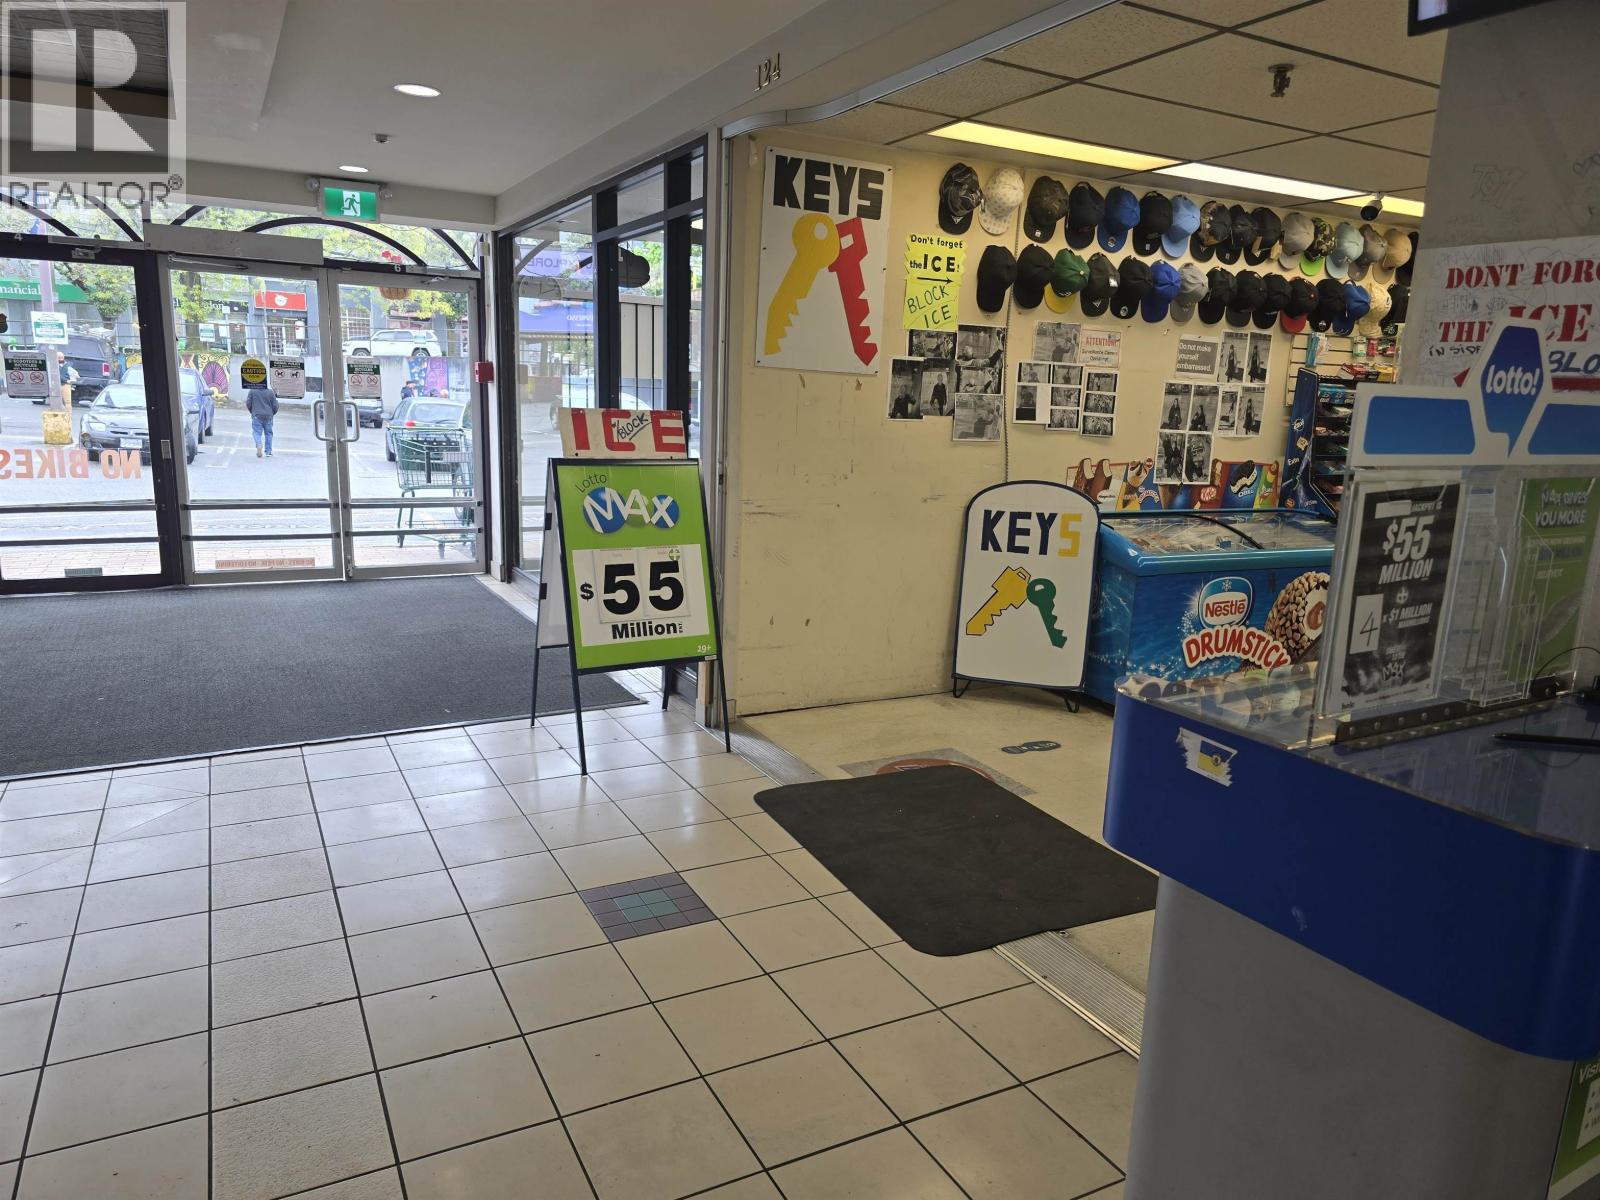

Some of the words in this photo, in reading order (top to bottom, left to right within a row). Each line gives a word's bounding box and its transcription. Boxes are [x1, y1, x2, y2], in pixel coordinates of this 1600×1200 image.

[752, 53, 781, 92] 124
[773, 154, 884, 221] KEYS
[910, 234, 934, 246] Don't
[936, 237, 963, 249] forget
[909, 259, 922, 269] the
[1445, 263, 1524, 289] DONT
[1532, 258, 1600, 285] FOR
[907, 284, 950, 314] BLOCK
[924, 304, 952, 328] ICE
[1178, 353, 1199, 361] yourself
[1179, 342, 1187, 350] Do
[1187, 344, 1196, 352] not
[1196, 345, 1212, 353] make
[1485, 364, 1540, 395] lotto!
[570, 407, 687, 453] ICE
[617, 412, 649, 441] BLOCK
[575, 473, 608, 493] Lotto
[583, 486, 674, 533] MAX
[1536, 511, 1557, 527] YOU
[1558, 510, 1586, 526] MORE
[981, 509, 1082, 557] KEYS
[1382, 515, 1435, 562] $55
[1378, 558, 1434, 585] MILLION
[1400, 603, 1433, 620] MILLION
[612, 621, 677, 640] Million
[1359, 611, 1378, 647] 4
[1185, 629, 1289, 668] DRUMSTICK
